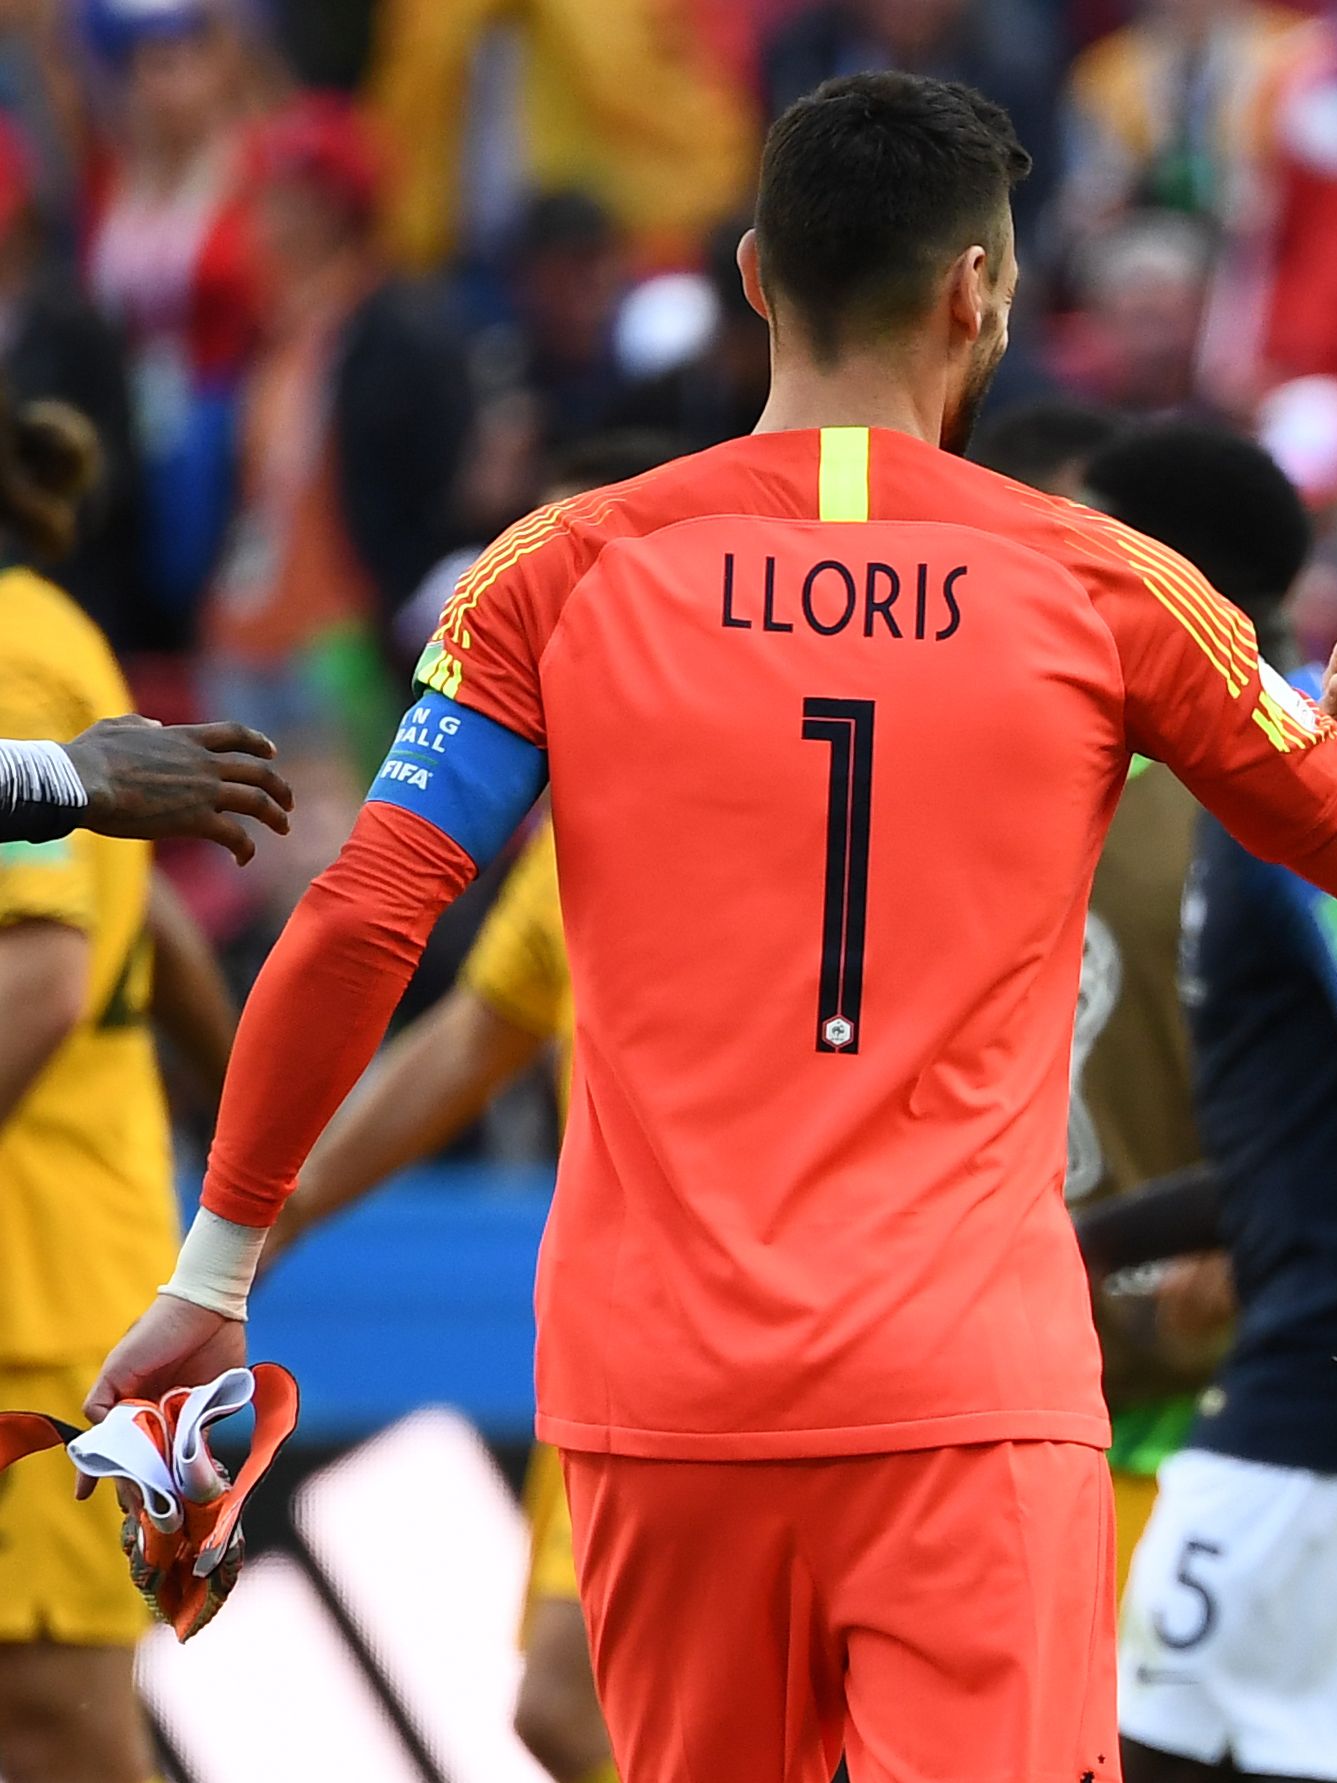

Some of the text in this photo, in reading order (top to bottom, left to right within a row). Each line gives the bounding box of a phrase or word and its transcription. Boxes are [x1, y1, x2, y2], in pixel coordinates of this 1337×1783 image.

[722, 553, 967, 641] LLORIS
[380, 759, 429, 790] FIFA
[802, 697, 875, 1054] 1
[1152, 1541, 1221, 1651] 5
